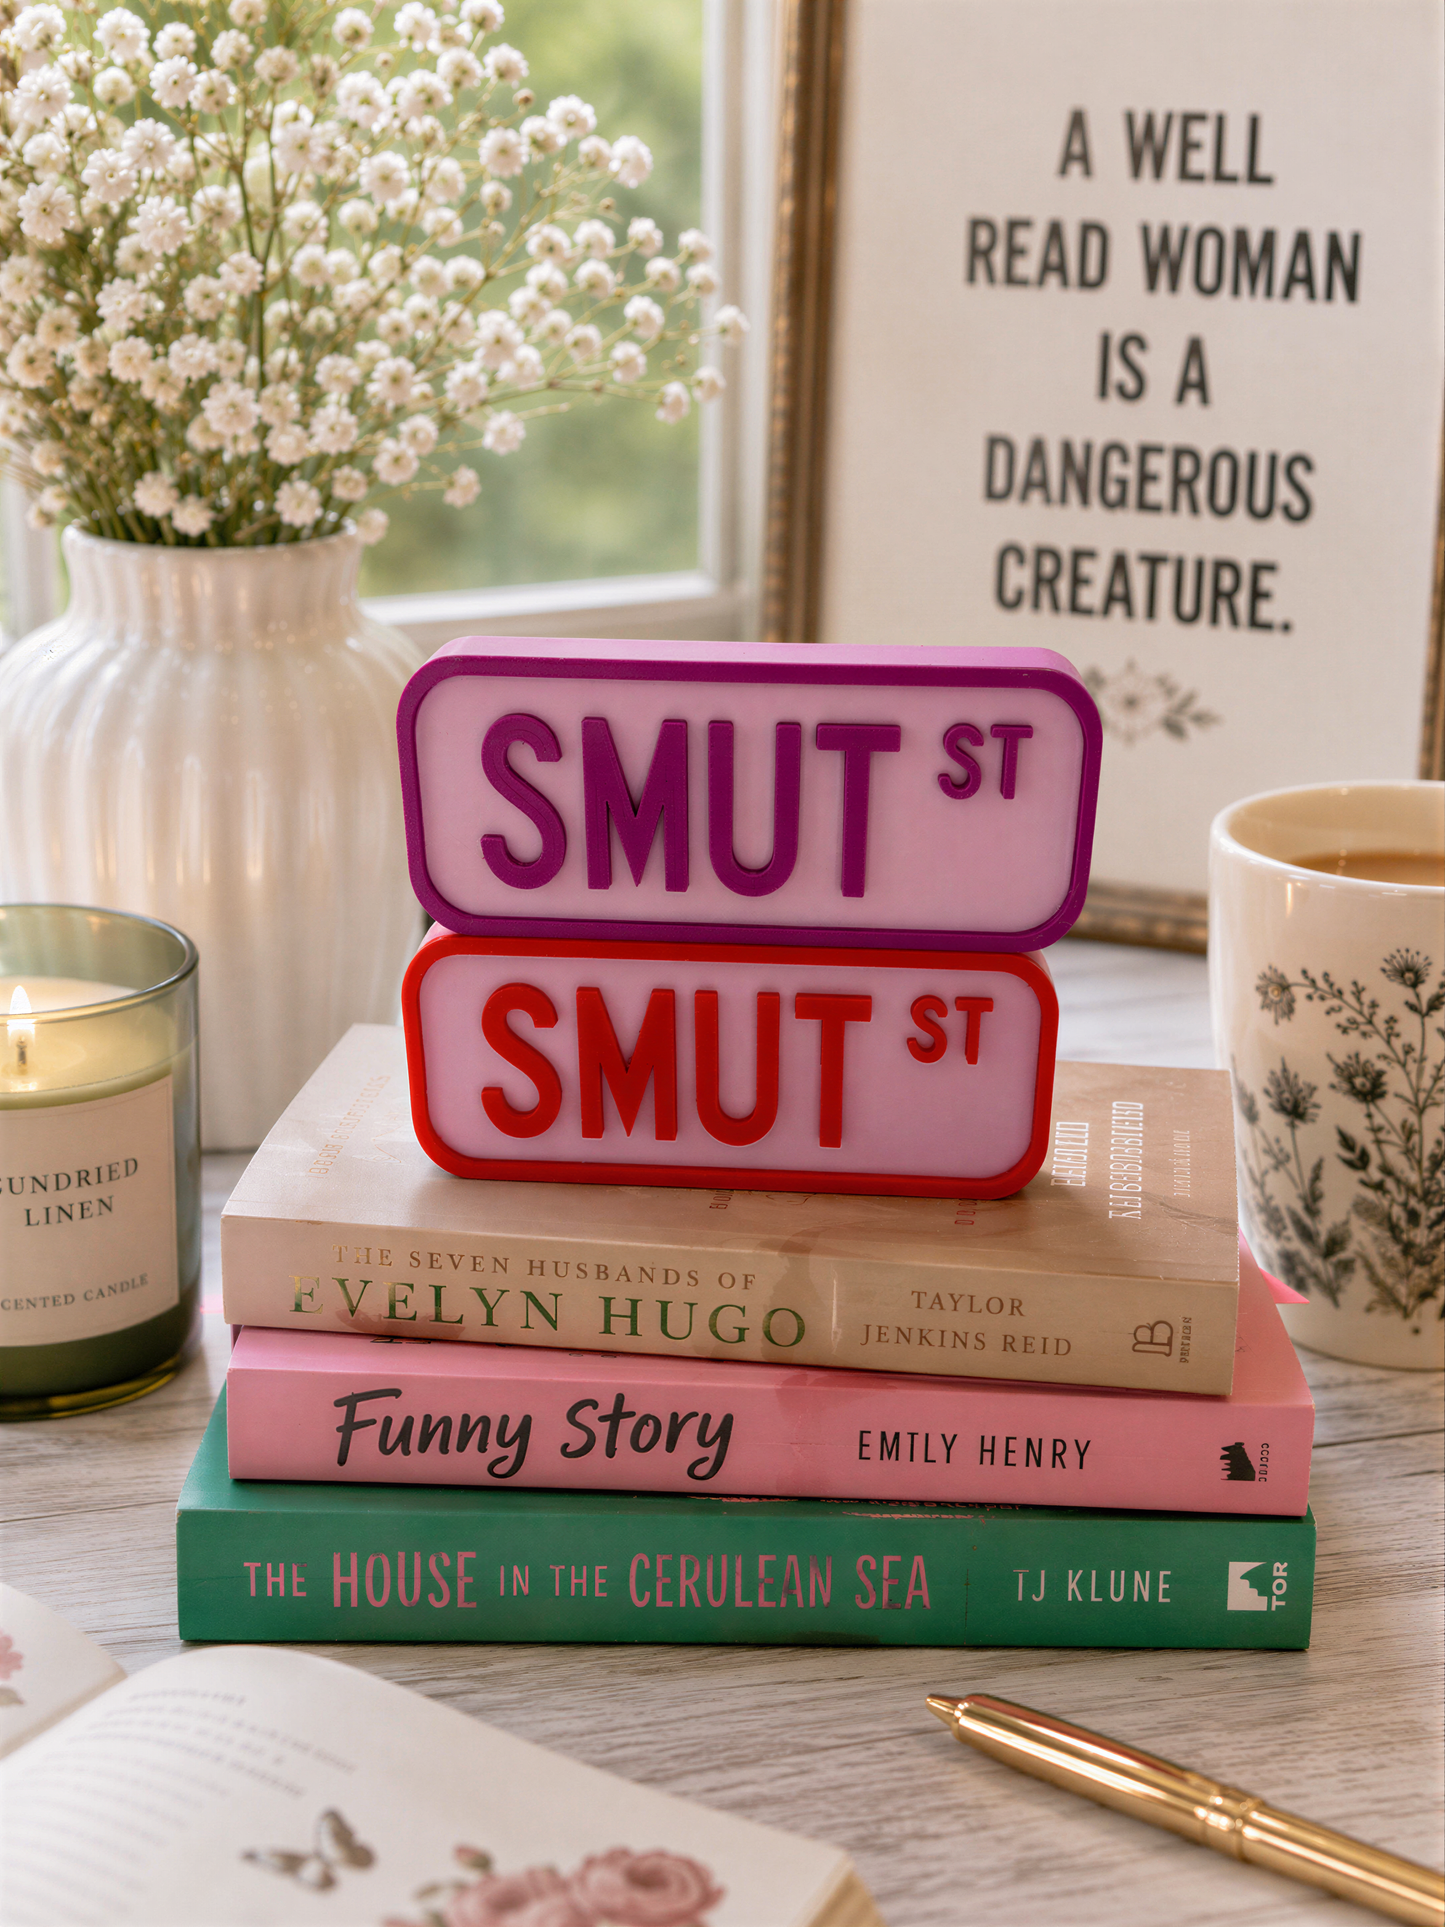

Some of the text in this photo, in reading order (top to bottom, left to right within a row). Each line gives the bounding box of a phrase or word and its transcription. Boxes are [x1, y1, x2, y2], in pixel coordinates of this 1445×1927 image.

[1058, 109, 1274, 185] A WELL
[966, 217, 1361, 303] READ WOMAN
[1098, 332, 1210, 406] IS A
[985, 435, 1314, 524] DANGEROUS
[995, 543, 1291, 633] CREATURE.
[481, 712, 1034, 898] SMUT ST
[481, 982, 872, 1148] SMUT
[906, 994, 994, 1065] ST
[0, 1158, 138, 1194] UNDRIED
[24, 1195, 114, 1227] LINEN
[83, 1273, 148, 1301] CANDLE
[332, 1244, 755, 1290] THE SEVEN HUSBANDS OF
[289, 1275, 806, 1348] EVELYN HUGO
[911, 1291, 1024, 1316] TAYLOR
[860, 1325, 1071, 1356] JENKINS REID
[333, 1388, 733, 1481] Funny Story
[980, 1435, 1090, 1469] HENRY
[244, 1551, 930, 1609] THE HOUSE IN THE CERULEAN SEA
[1014, 1570, 1171, 1602] TJ KLUNE
[1271, 1562, 1288, 1611] TOR
